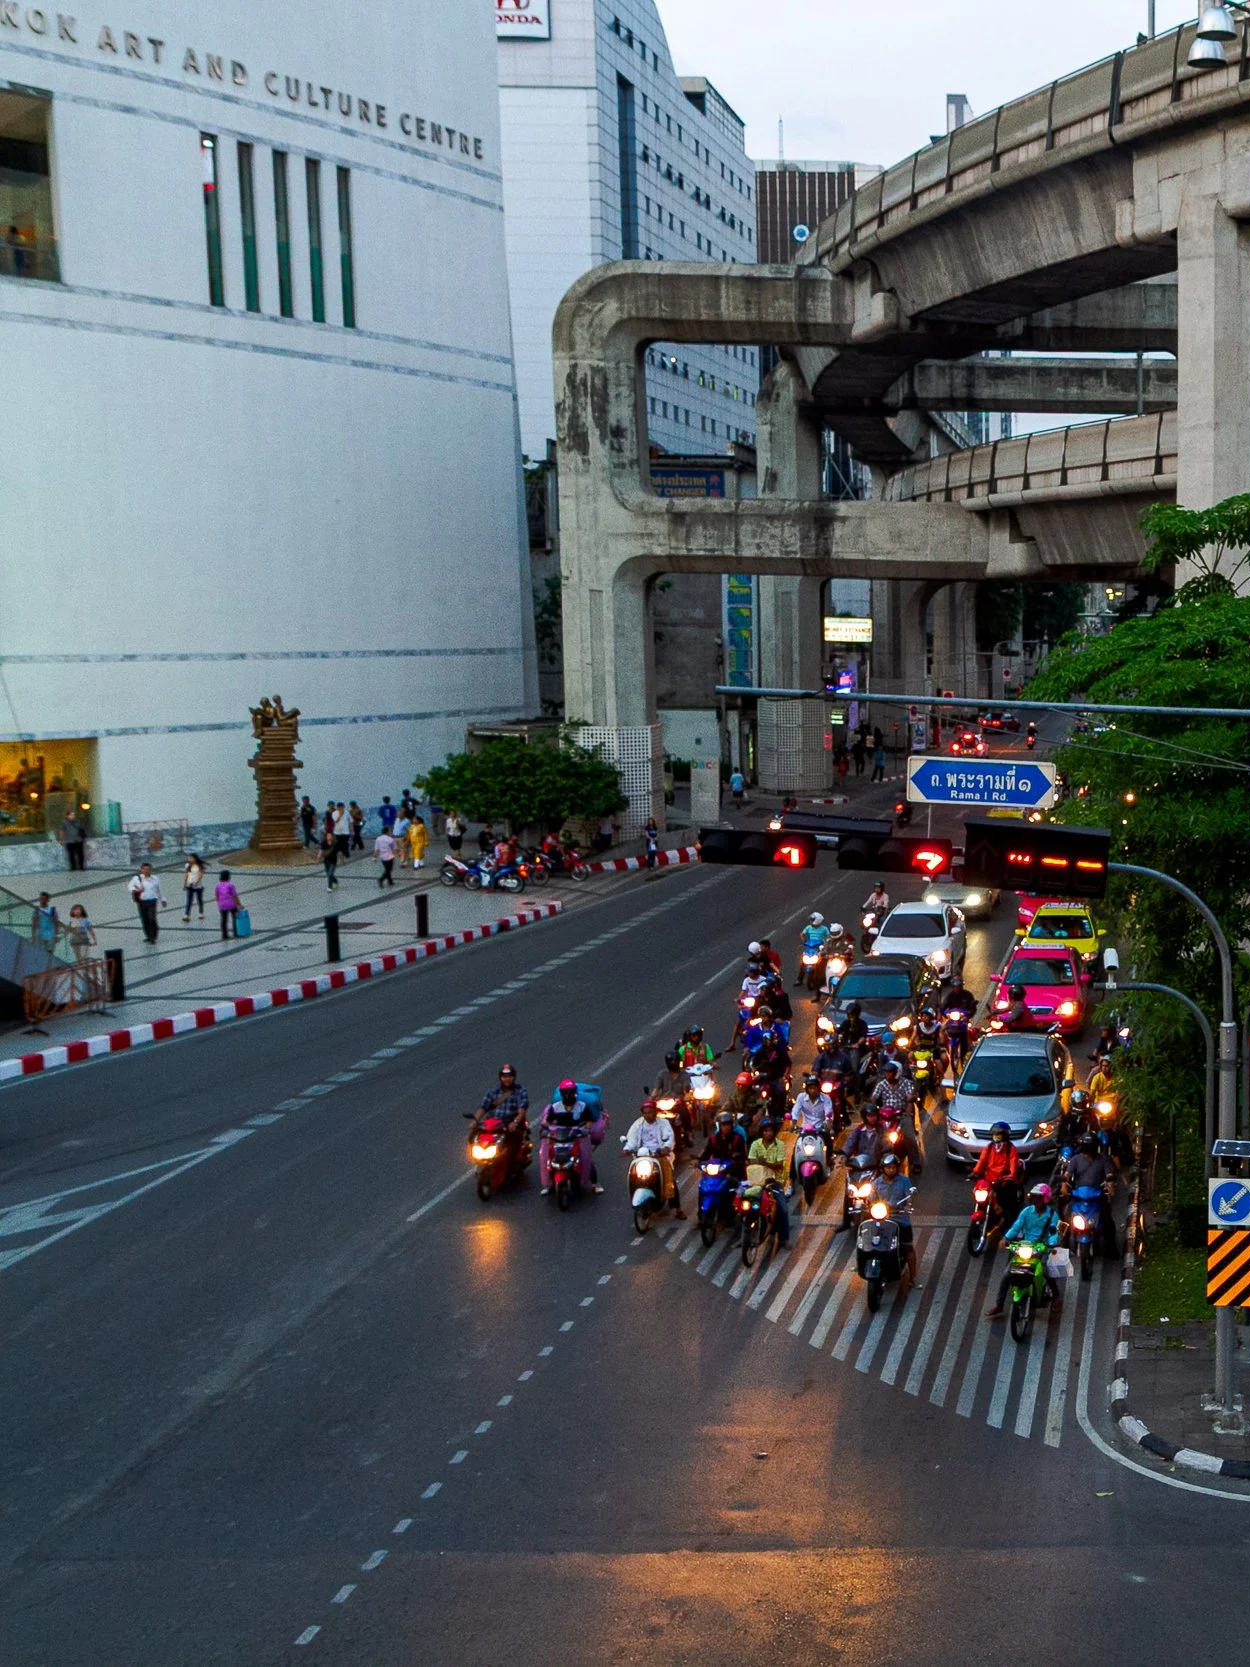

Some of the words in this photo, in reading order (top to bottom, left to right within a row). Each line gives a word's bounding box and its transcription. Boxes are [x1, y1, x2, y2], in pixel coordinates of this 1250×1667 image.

[0, 1, 78, 43] KOK
[98, 25, 164, 64] ART
[183, 48, 248, 86] AND
[264, 71, 387, 128] CULTURE
[400, 113, 484, 159] CENTRE
[950, 790, 980, 800] Rama
[992, 791, 1009, 801] Rd.
